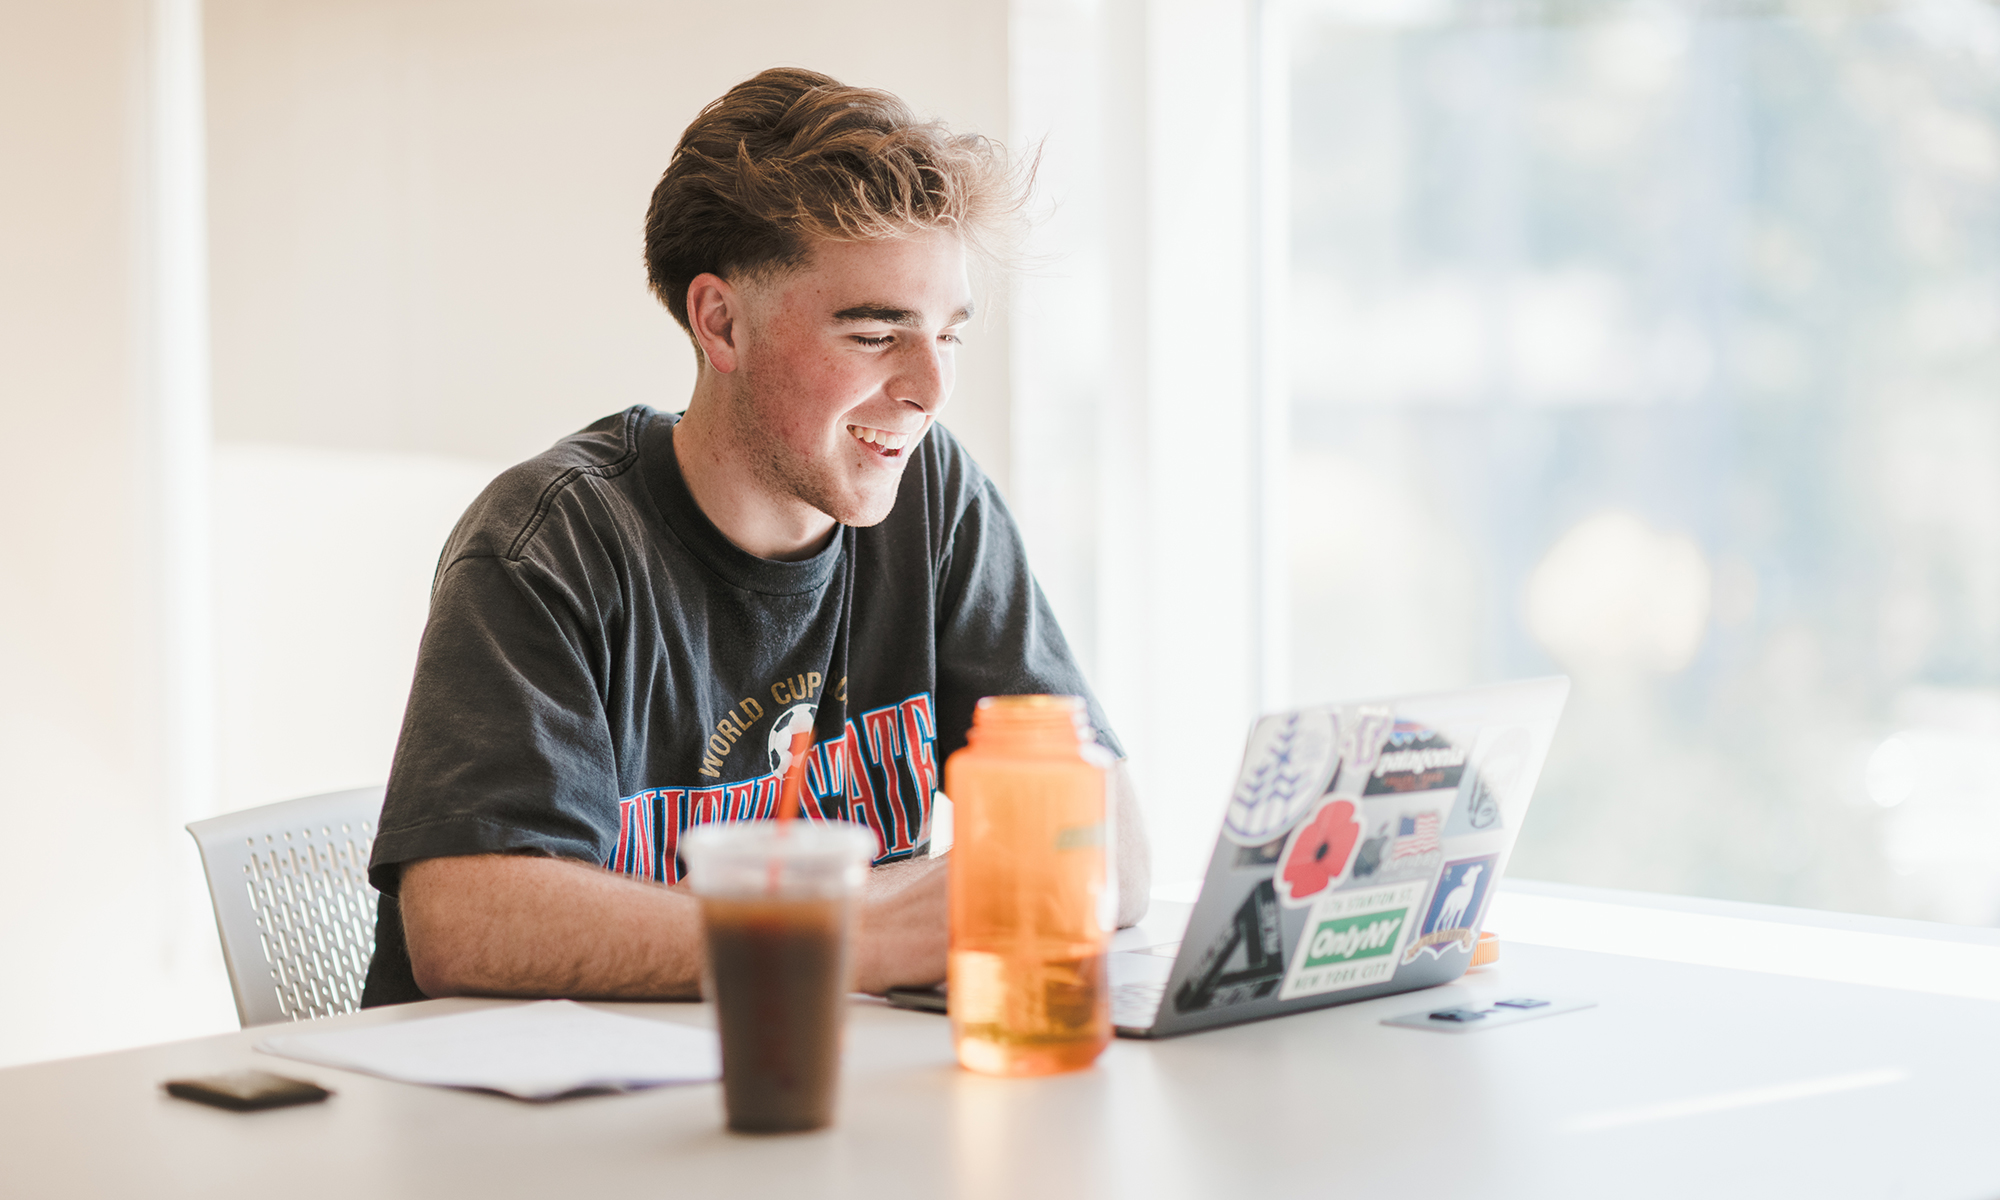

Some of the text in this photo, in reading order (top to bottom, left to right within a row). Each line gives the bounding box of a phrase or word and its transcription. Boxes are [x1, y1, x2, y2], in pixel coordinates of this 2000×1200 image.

[698, 697, 764, 779] WORLD
[770, 671, 822, 705] CUP
[1294, 962, 1390, 990] NEW YORK CITY
